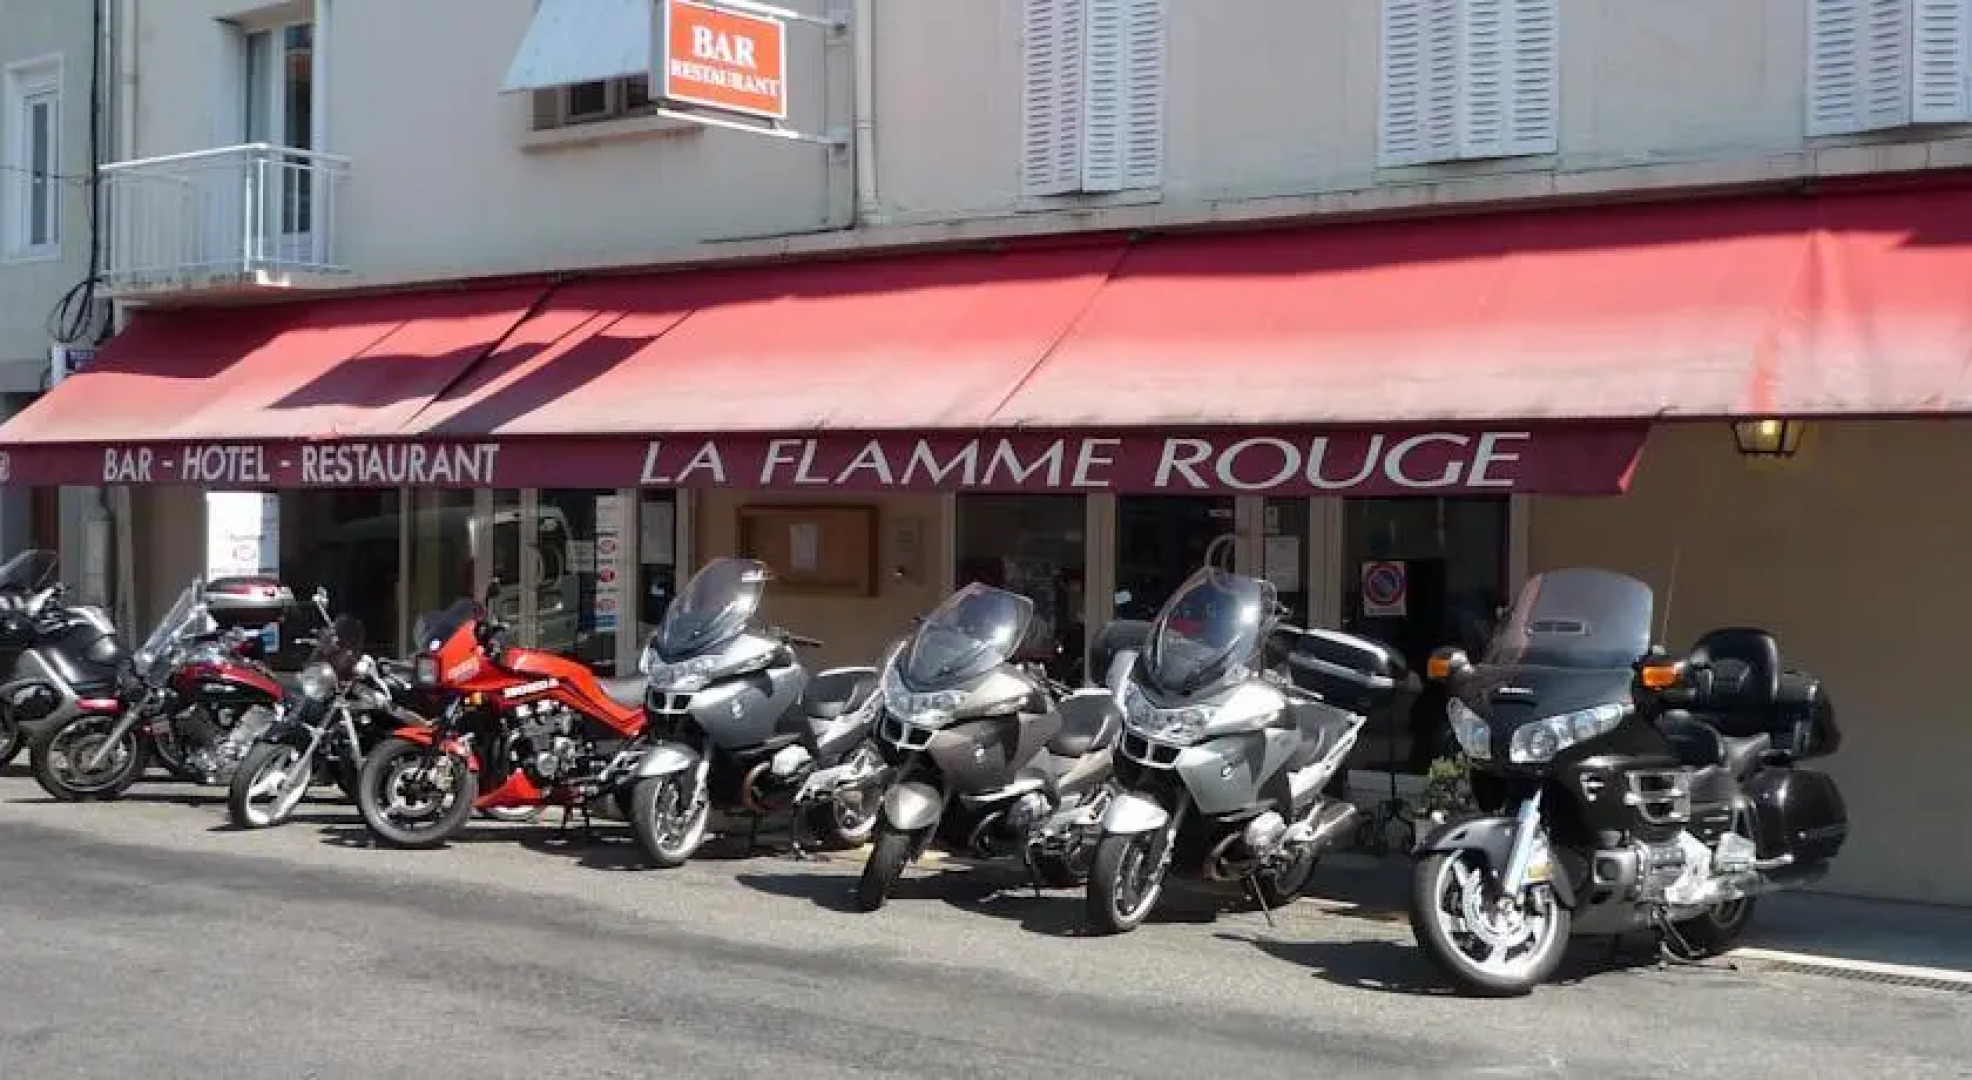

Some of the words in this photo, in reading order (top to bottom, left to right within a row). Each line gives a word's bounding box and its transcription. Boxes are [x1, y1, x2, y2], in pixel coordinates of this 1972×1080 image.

[692, 25, 757, 68] BAR
[670, 58, 781, 97] RESTAURANT
[103, 447, 152, 482] BAR
[182, 445, 271, 482] HOTEL
[301, 443, 499, 483] RESTAURANT
[640, 440, 726, 485] LA
[760, 438, 1121, 487] FLAMME
[1154, 431, 1531, 489] ROUGE
